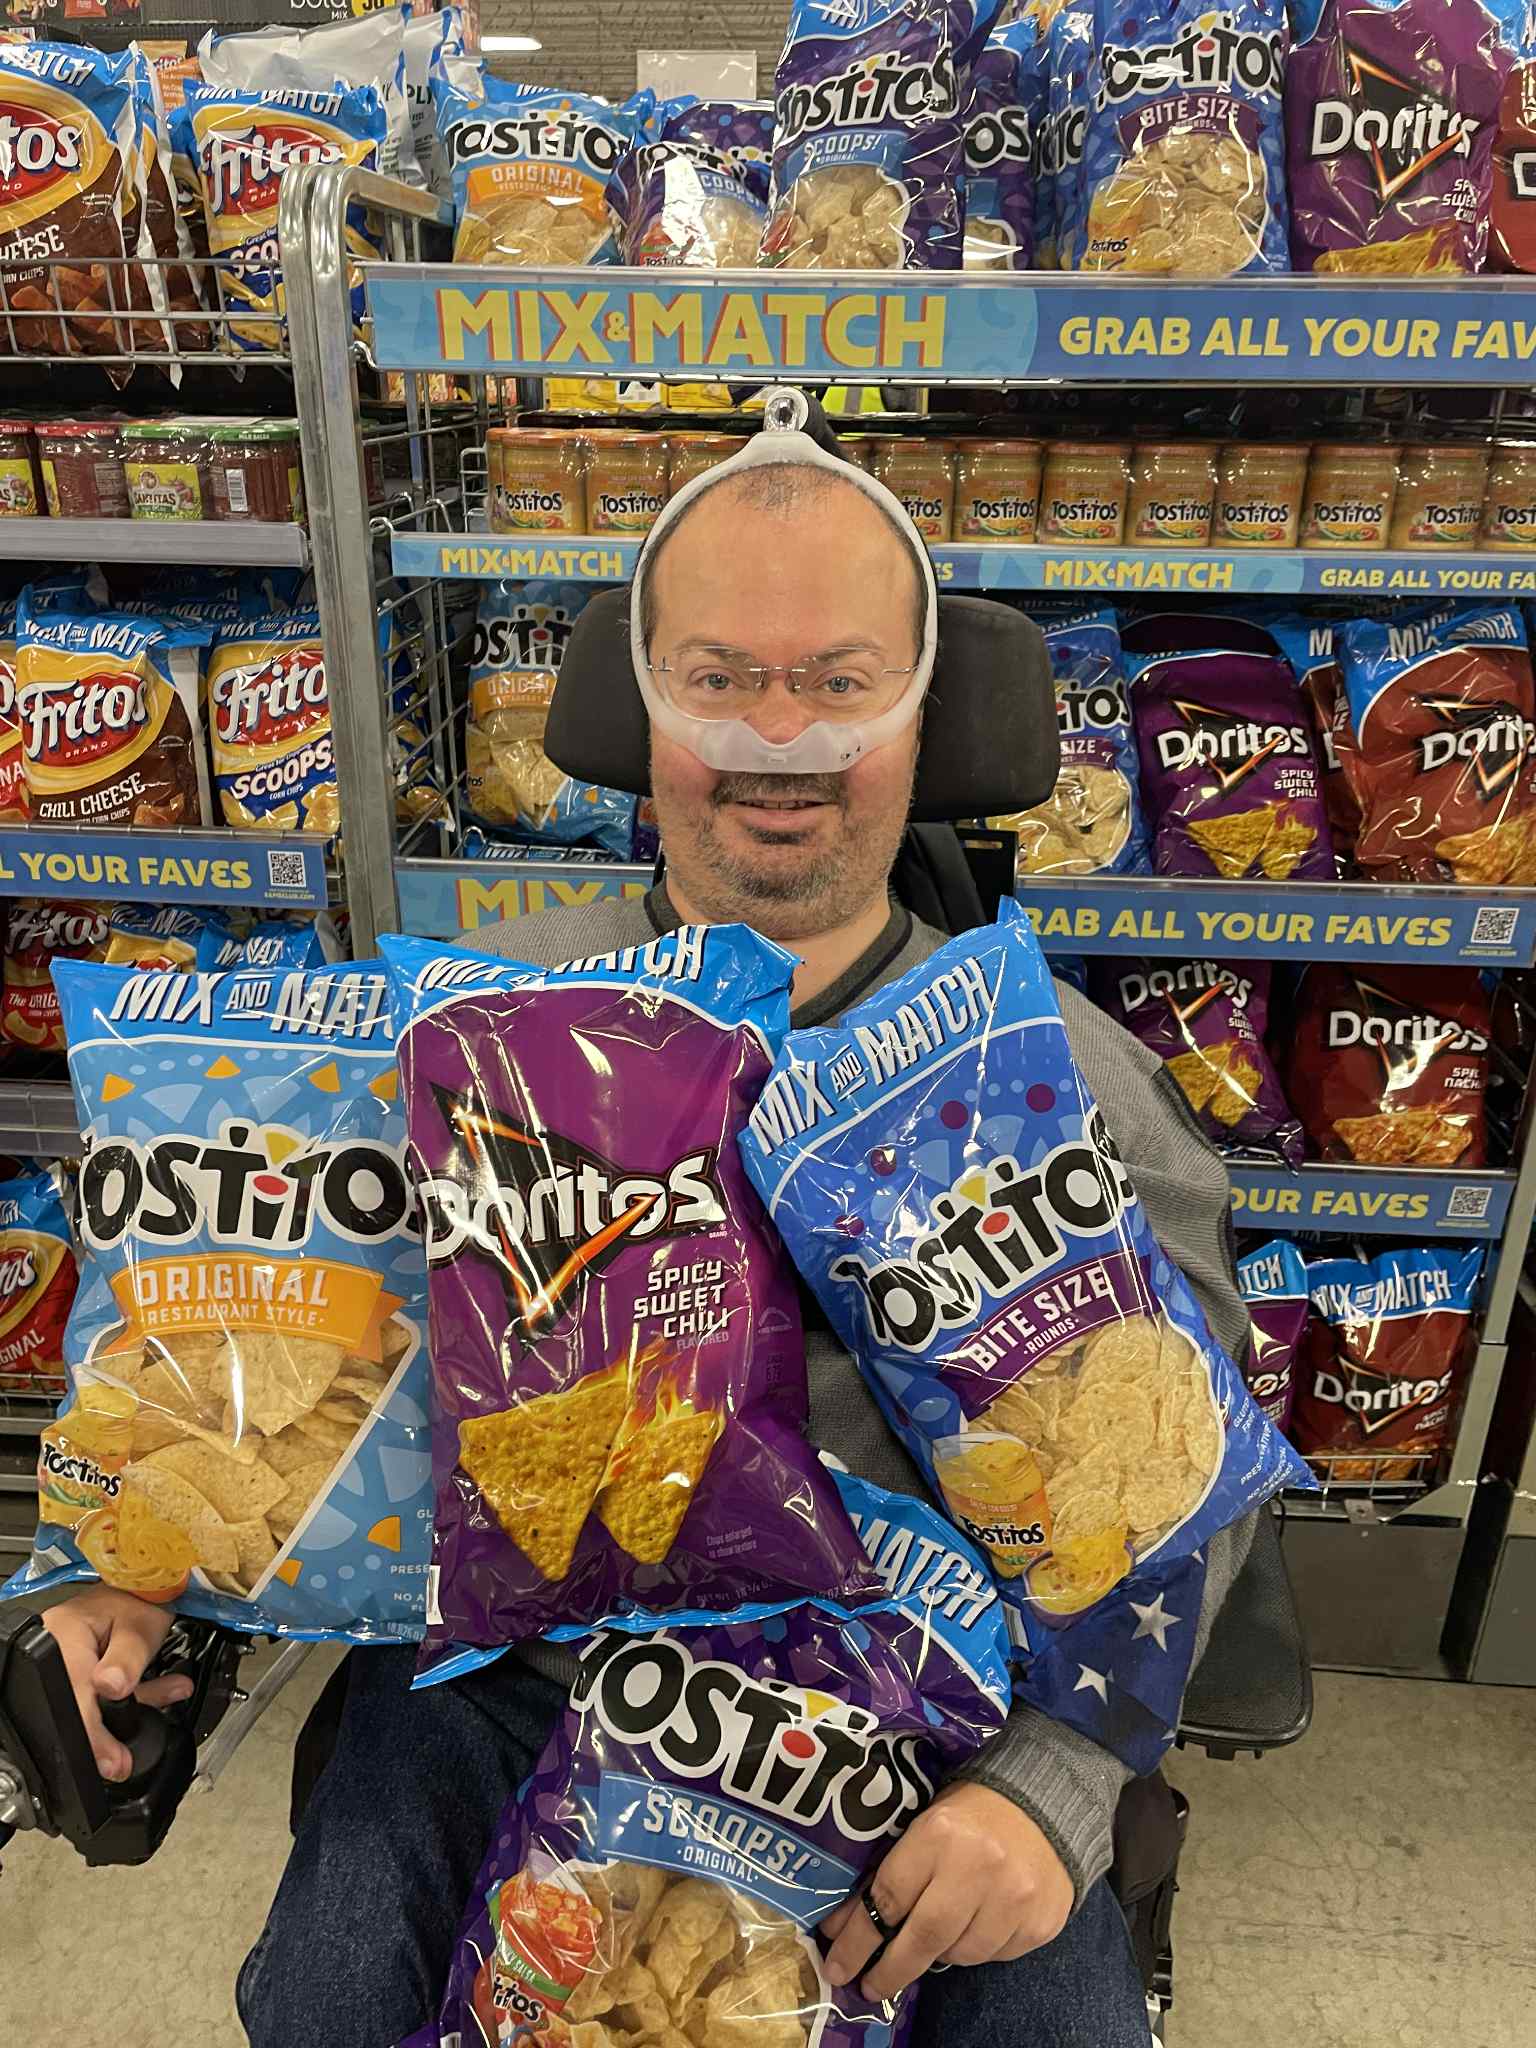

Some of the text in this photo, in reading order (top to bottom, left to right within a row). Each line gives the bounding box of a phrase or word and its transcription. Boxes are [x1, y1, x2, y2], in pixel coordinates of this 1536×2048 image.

[1140, 96, 1239, 128] BITE SIZE
[1311, 100, 1481, 160] Doritos
[492, 166, 583, 194] ORIGINAL
[1058, 315, 1191, 357] GRAB
[1199, 317, 1290, 357] ALL
[1303, 318, 1440, 358] YOUR
[1320, 568, 1385, 588] GRAB
[1388, 570, 1431, 588] ALL
[1437, 570, 1505, 590] YOUR
[18, 679, 148, 760] Fritos
[65, 741, 108, 758] BRAND
[1157, 722, 1308, 769] Doritos
[1274, 779, 1316, 791] SWEET
[1281, 769, 1313, 780] SPICY
[1288, 788, 1317, 799] CHILI
[40, 772, 144, 818] CHILI CHEESE
[20, 852, 130, 885] YOUR
[139, 857, 252, 889] FAVES
[1111, 909, 1184, 939] ALL
[1196, 911, 1312, 944] YOUR
[1324, 915, 1452, 947] FAVES
[110, 973, 228, 1026] MIX
[229, 982, 275, 1009] AND
[1119, 960, 1253, 1013] Doritos
[1329, 1010, 1489, 1052] Doritos
[752, 956, 993, 1157] MIX AND MATCH
[419, 1156, 728, 1262] Doritos
[1311, 1191, 1429, 1218] FAVES
[137, 1263, 329, 1308] ORIGINAL
[647, 1260, 722, 1292] SPICY
[146, 1305, 317, 1327] RESTAURANT STYLE
[633, 1284, 726, 1320] SWEET
[968, 1268, 1109, 1373] BITE SIZE
[663, 1307, 729, 1339] CHILI
[1314, 1369, 1452, 1413] Doritos
[572, 1629, 938, 1834] TOSTITOS
[643, 1791, 812, 1883] SCOOPS!
[681, 1847, 757, 1883] ORIGINAL
